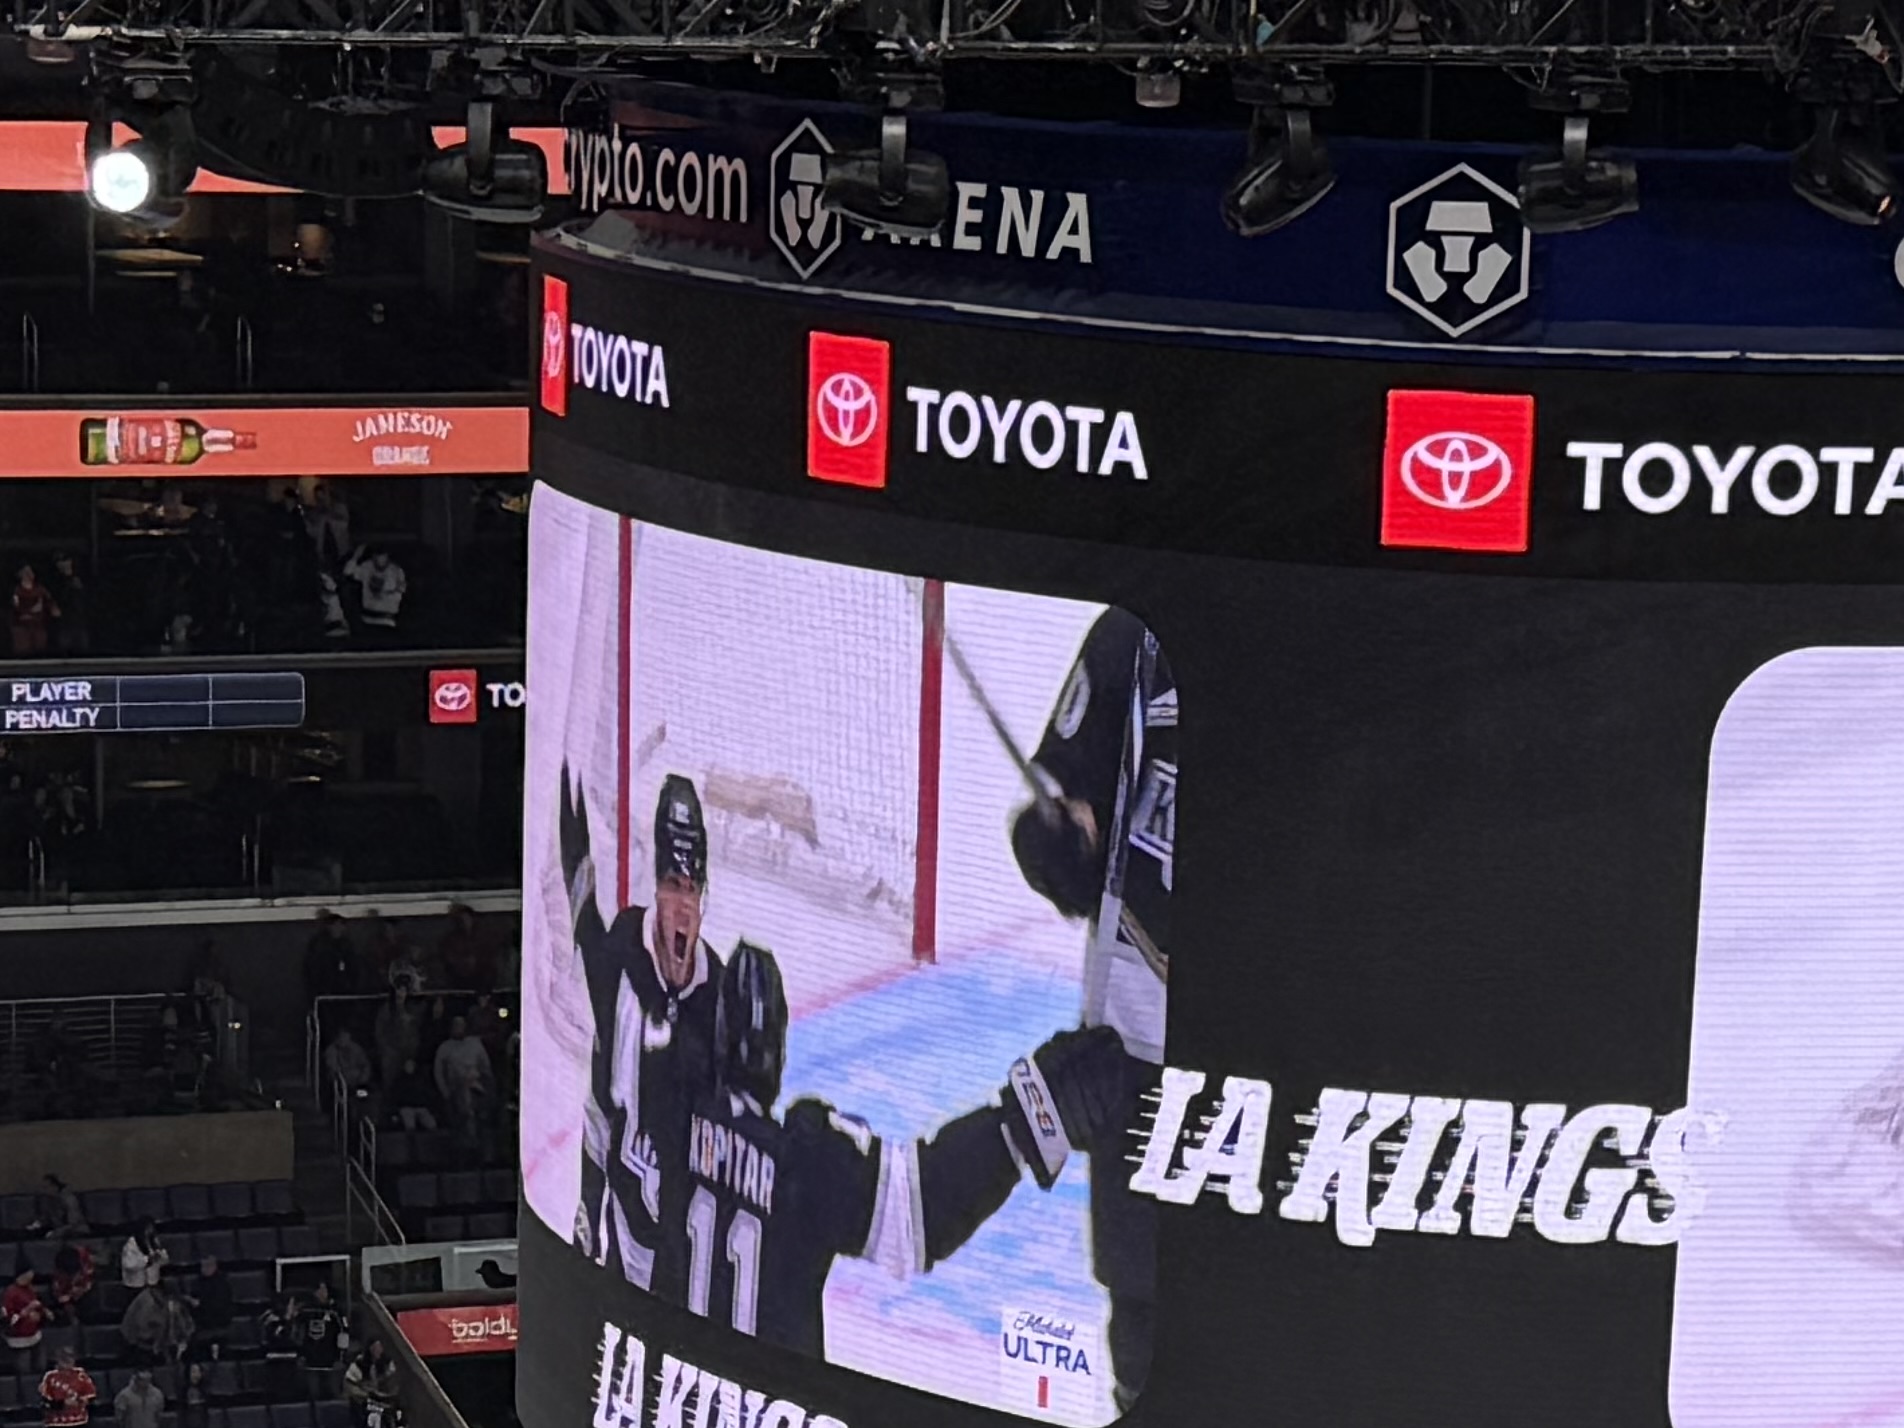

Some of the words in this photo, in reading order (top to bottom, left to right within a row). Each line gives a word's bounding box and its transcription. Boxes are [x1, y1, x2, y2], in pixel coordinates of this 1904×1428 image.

[570, 323, 670, 408] TOYOTA
[352, 410, 452, 444] JAMESON
[907, 386, 1149, 480] TOYOTA
[4, 706, 100, 731] PENALTY
[11, 680, 92, 704] PLAYER
[690, 1113, 776, 1215] KOPITAR
[1130, 1065, 1274, 1217] LA
[1280, 1088, 1706, 1249] KINGS
[686, 1184, 764, 1338] 11
[1002, 1332, 1093, 1377] ULTRA
